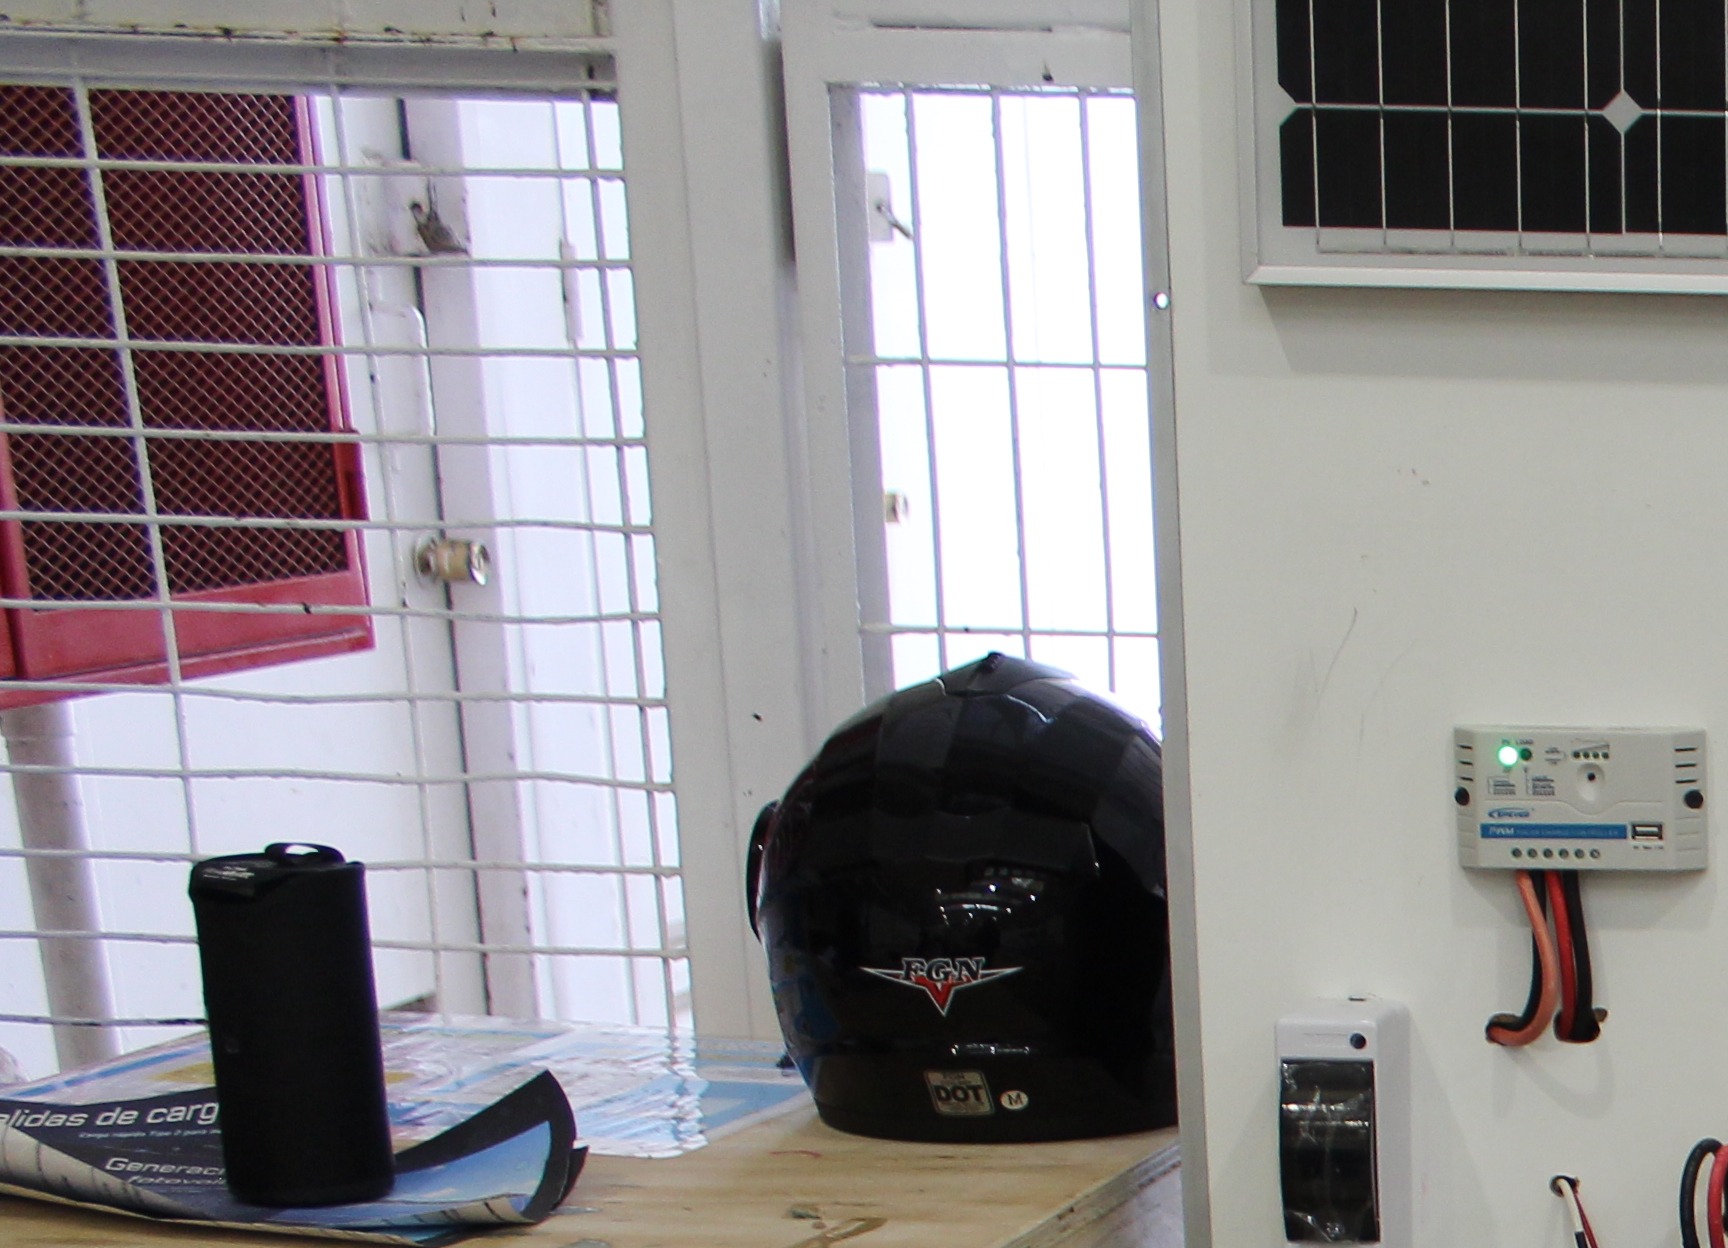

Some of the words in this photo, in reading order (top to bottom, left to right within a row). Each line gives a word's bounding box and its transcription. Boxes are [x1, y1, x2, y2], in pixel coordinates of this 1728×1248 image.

[933, 1085, 985, 1105] DOT
[1008, 1093, 1023, 1106] M
[96, 1107, 139, 1126] de
[146, 1102, 220, 1125] carg
